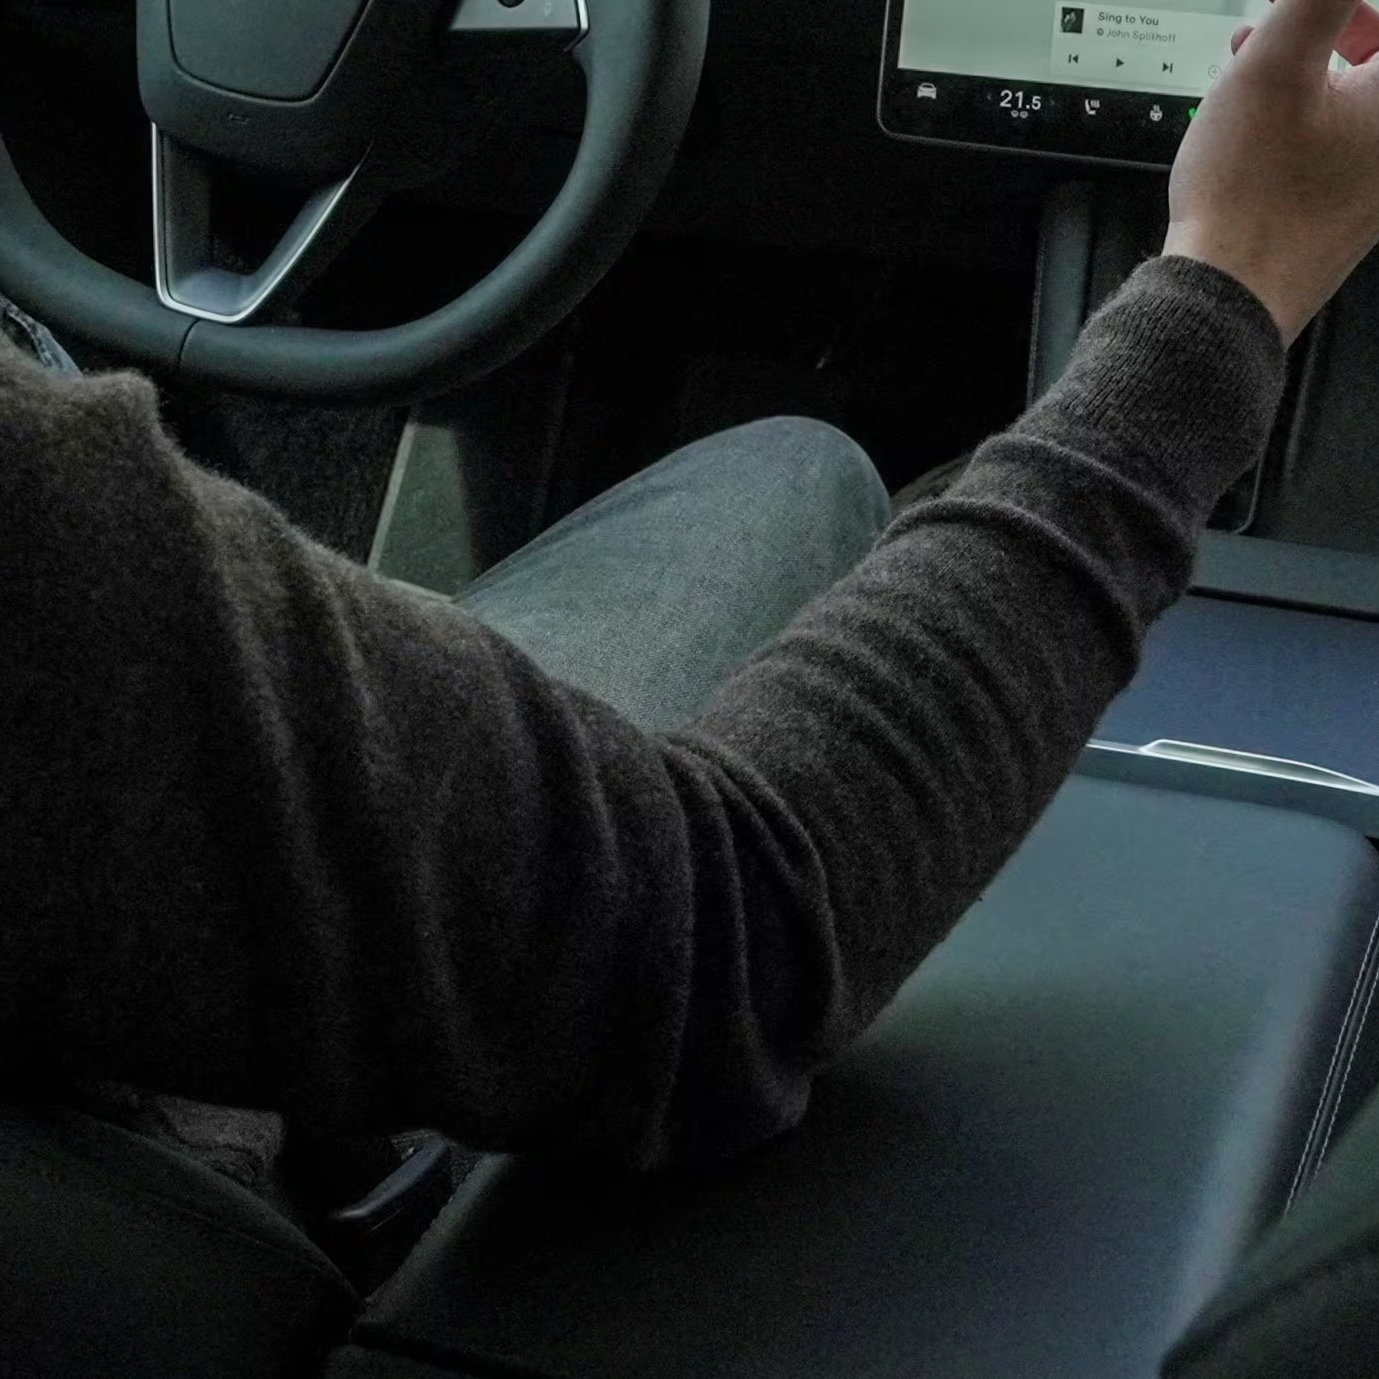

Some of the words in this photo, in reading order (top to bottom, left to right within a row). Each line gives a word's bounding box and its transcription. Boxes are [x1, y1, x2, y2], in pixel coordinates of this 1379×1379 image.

[1098, 11, 1122, 24] Sing
[1125, 13, 1136, 24] to
[1139, 14, 1160, 26] You
[1106, 28, 1130, 39] John
[999, 89, 1042, 111] 21.5
